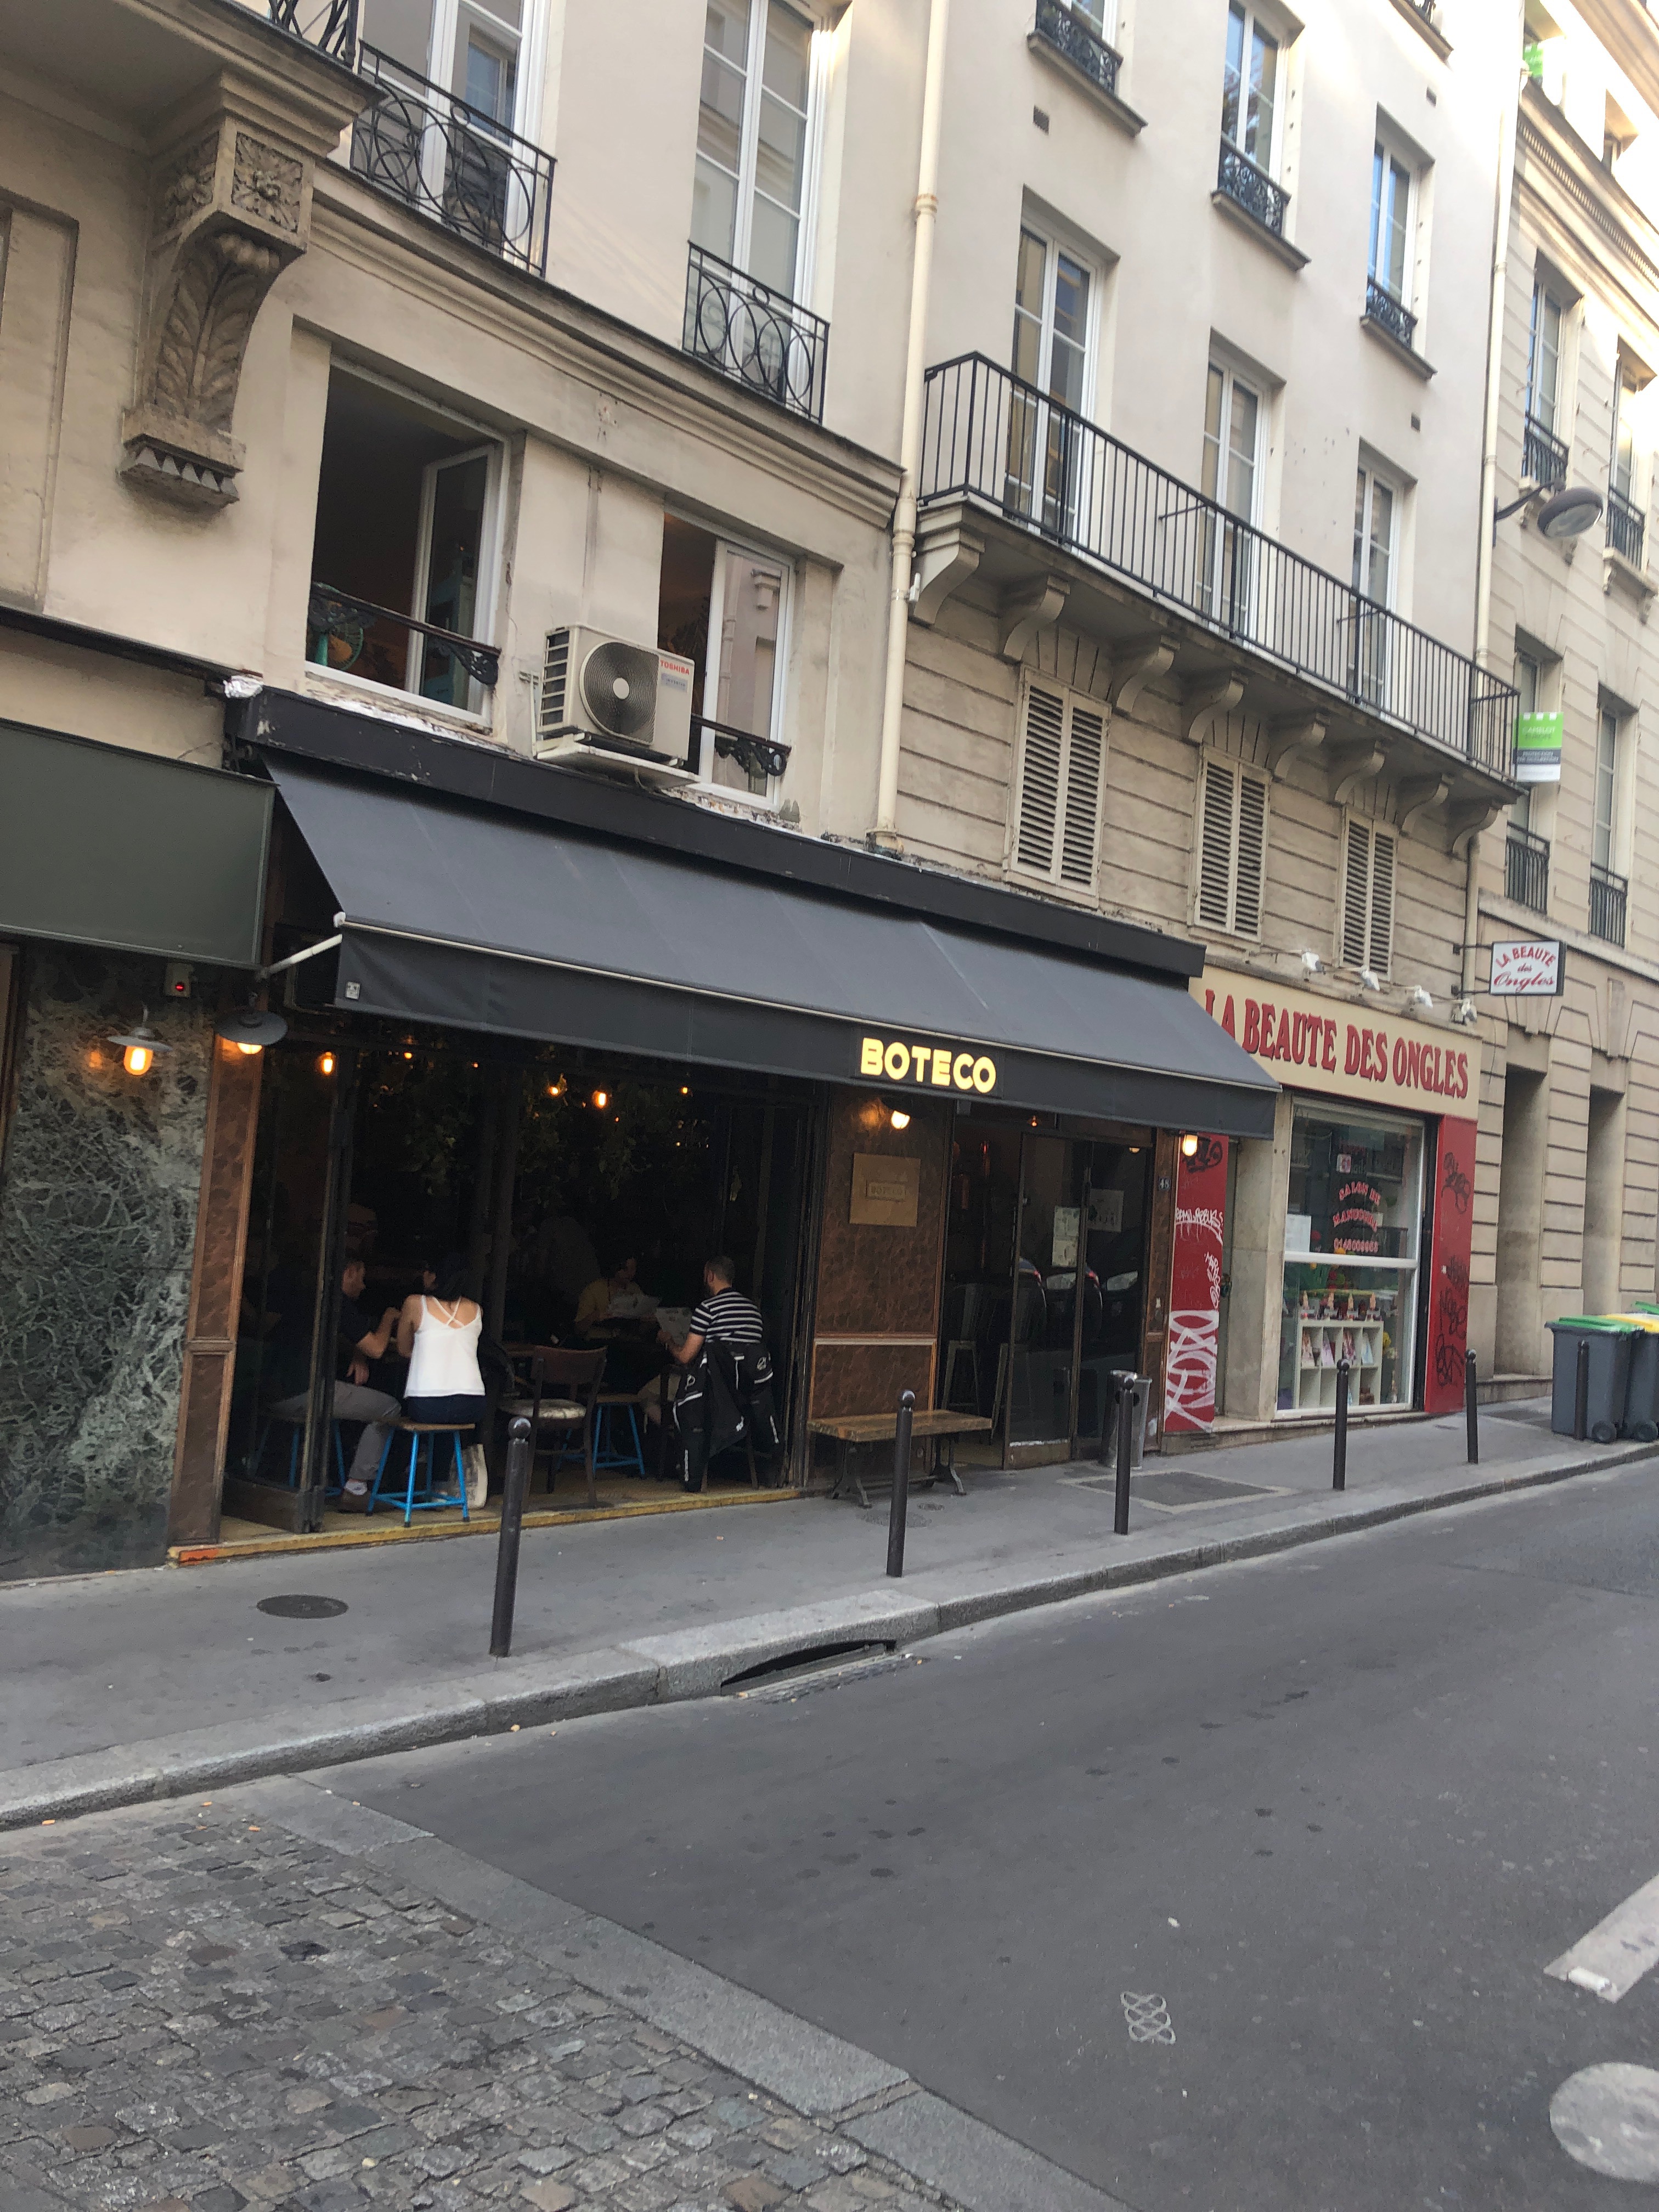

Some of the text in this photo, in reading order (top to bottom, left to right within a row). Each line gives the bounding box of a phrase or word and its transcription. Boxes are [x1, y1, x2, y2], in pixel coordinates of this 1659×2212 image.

[660, 659, 690, 675] TOSHIBA
[1496, 945, 1556, 969] LA BEAUTE
[1517, 962, 1532, 973] des
[1494, 971, 1554, 994] Ongles
[1242, 998, 1337, 1075] BEAUTE
[1344, 1024, 1387, 1082] DES
[1392, 1036, 1468, 1099] ONGLES
[860, 1037, 996, 1093] BOTECO
[1160, 1178, 1169, 1189] 48
[1339, 1181, 1369, 1201] SALON
